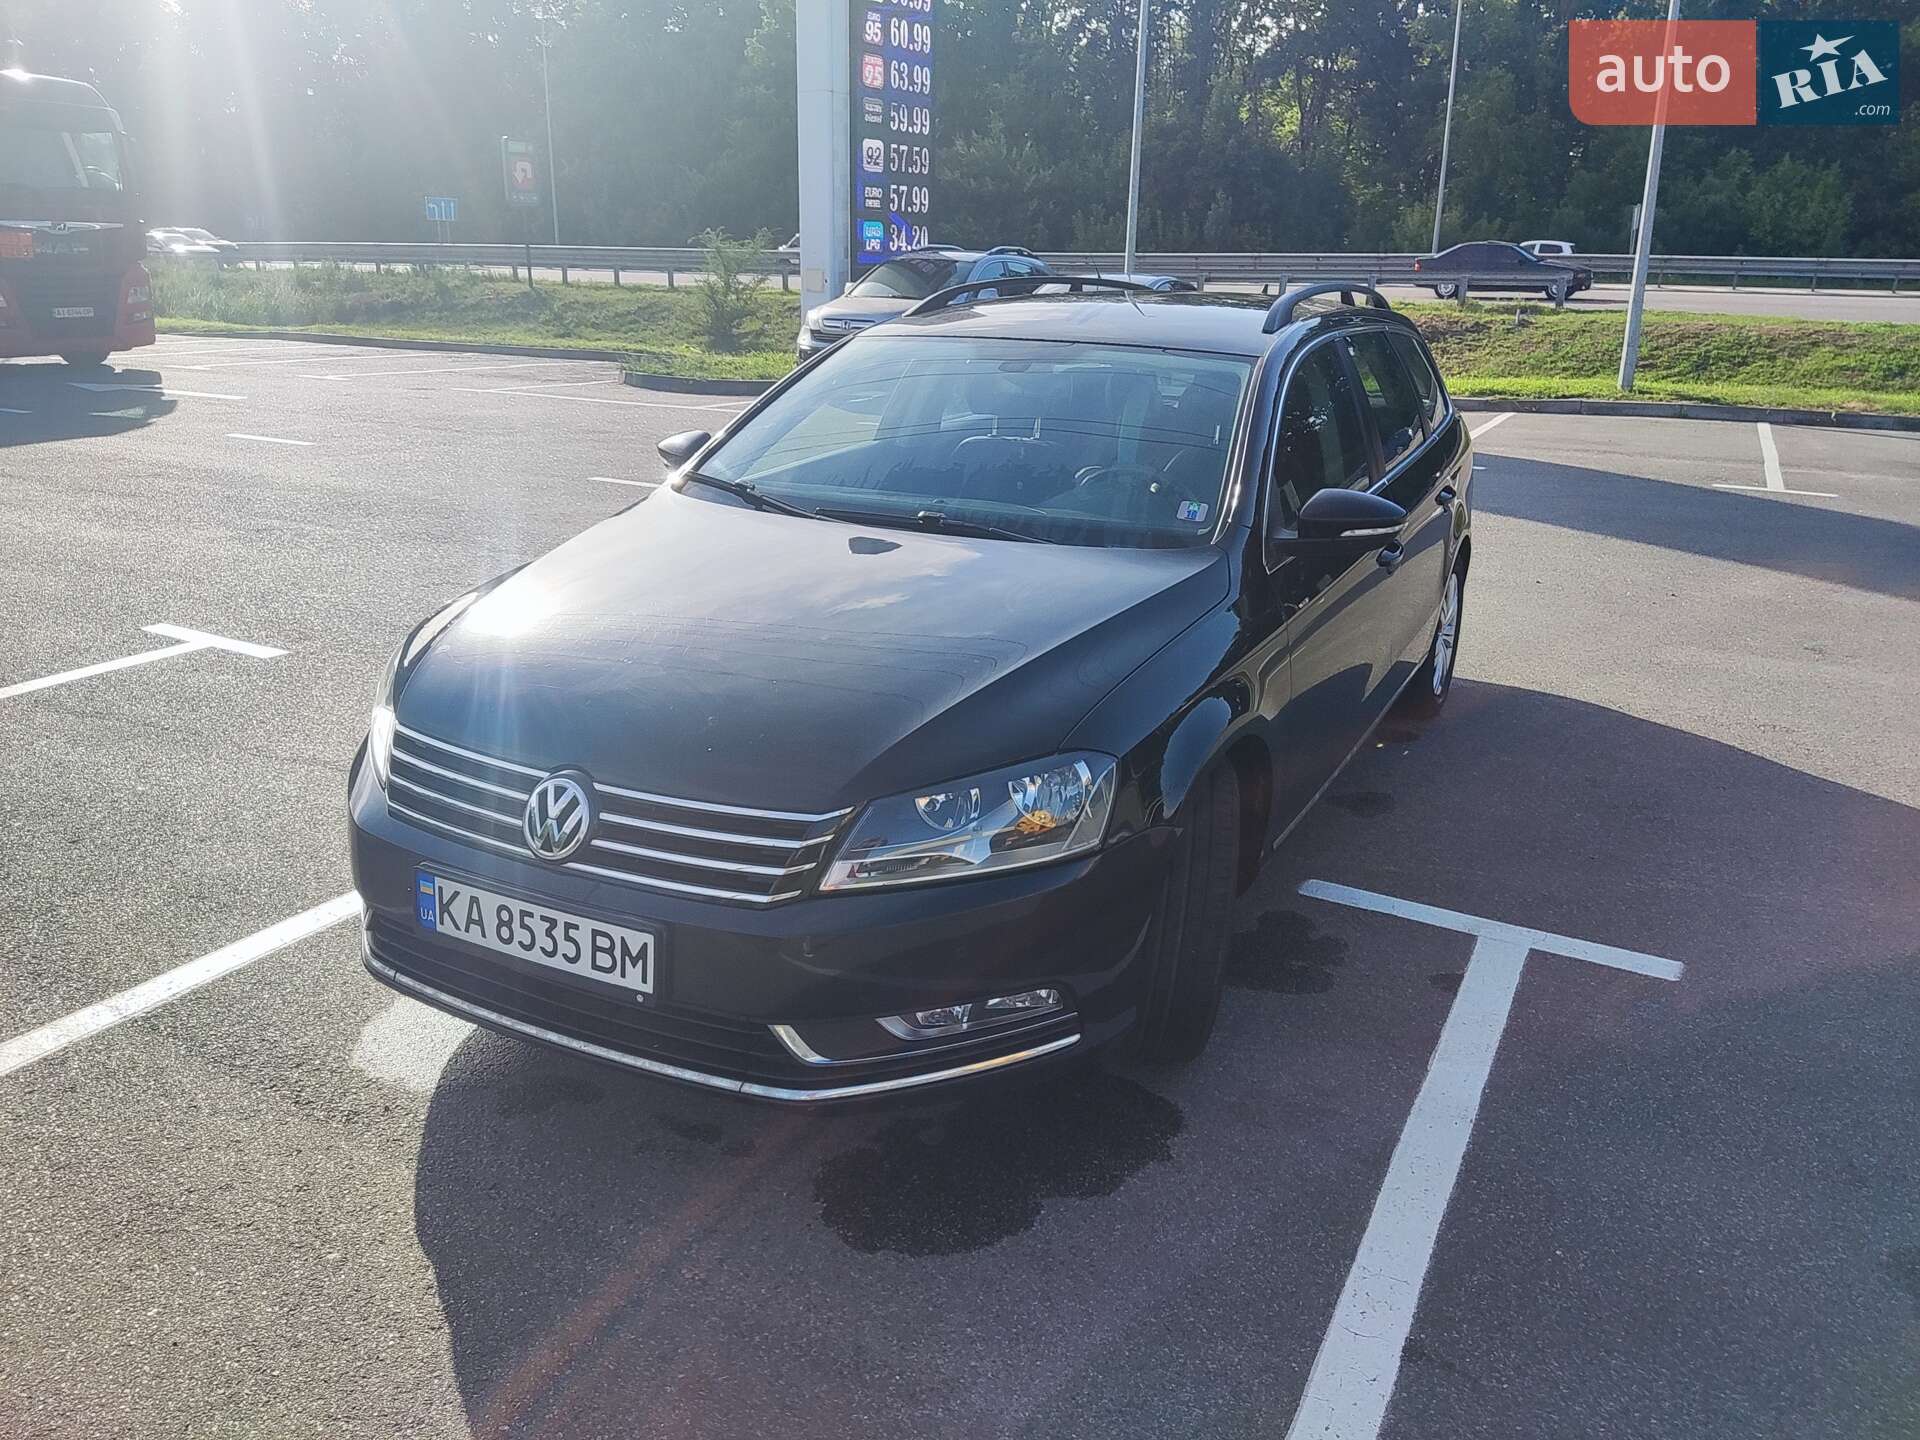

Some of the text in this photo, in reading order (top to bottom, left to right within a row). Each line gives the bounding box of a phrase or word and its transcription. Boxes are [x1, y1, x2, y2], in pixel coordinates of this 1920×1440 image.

[864, 20, 882, 42] 95
[890, 17, 931, 54] 60.99
[890, 60, 931, 95] 63.99
[889, 102, 930, 136] 59.99
[866, 146, 881, 167] 92
[890, 143, 930, 175] 57.59
[889, 184, 929, 214] 57.99
[889, 224, 929, 252] 34.20
[420, 907, 435, 922] UA
[438, 885, 649, 985] KA 8535 BM
